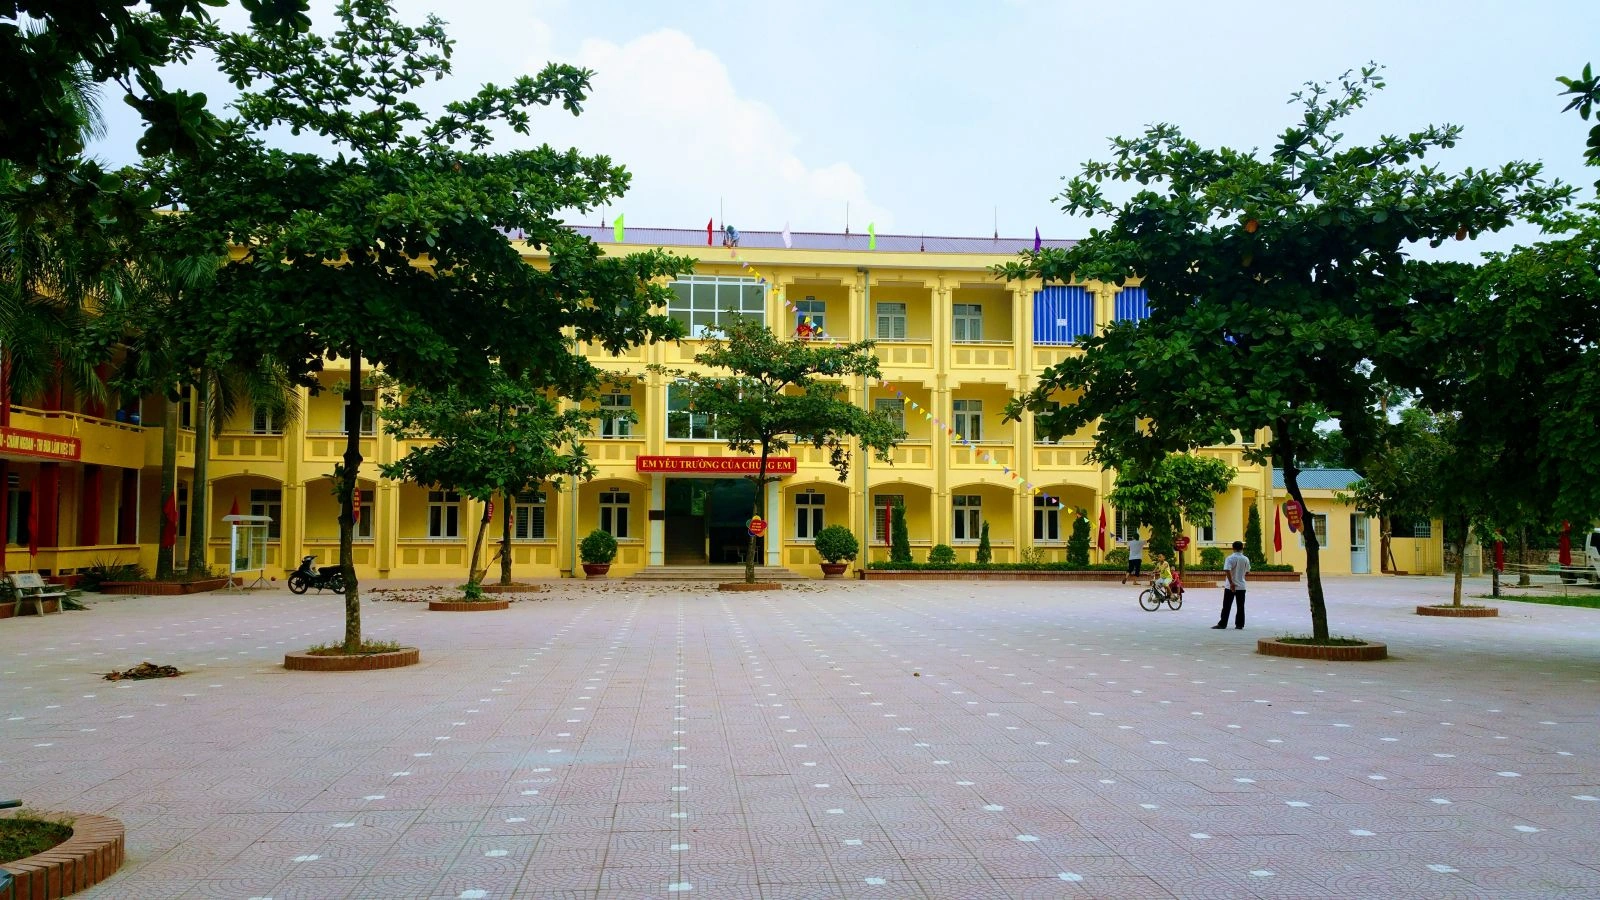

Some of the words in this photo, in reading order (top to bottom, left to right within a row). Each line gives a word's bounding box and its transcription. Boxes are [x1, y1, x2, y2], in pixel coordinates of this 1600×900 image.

[642, 459, 657, 468] EM
[659, 458, 677, 469] YÊU
[680, 459, 719, 469] TRƯỜNG
[721, 459, 740, 470] CỦA
[741, 459, 775, 470] CHÚG
[777, 461, 791, 470] EM
